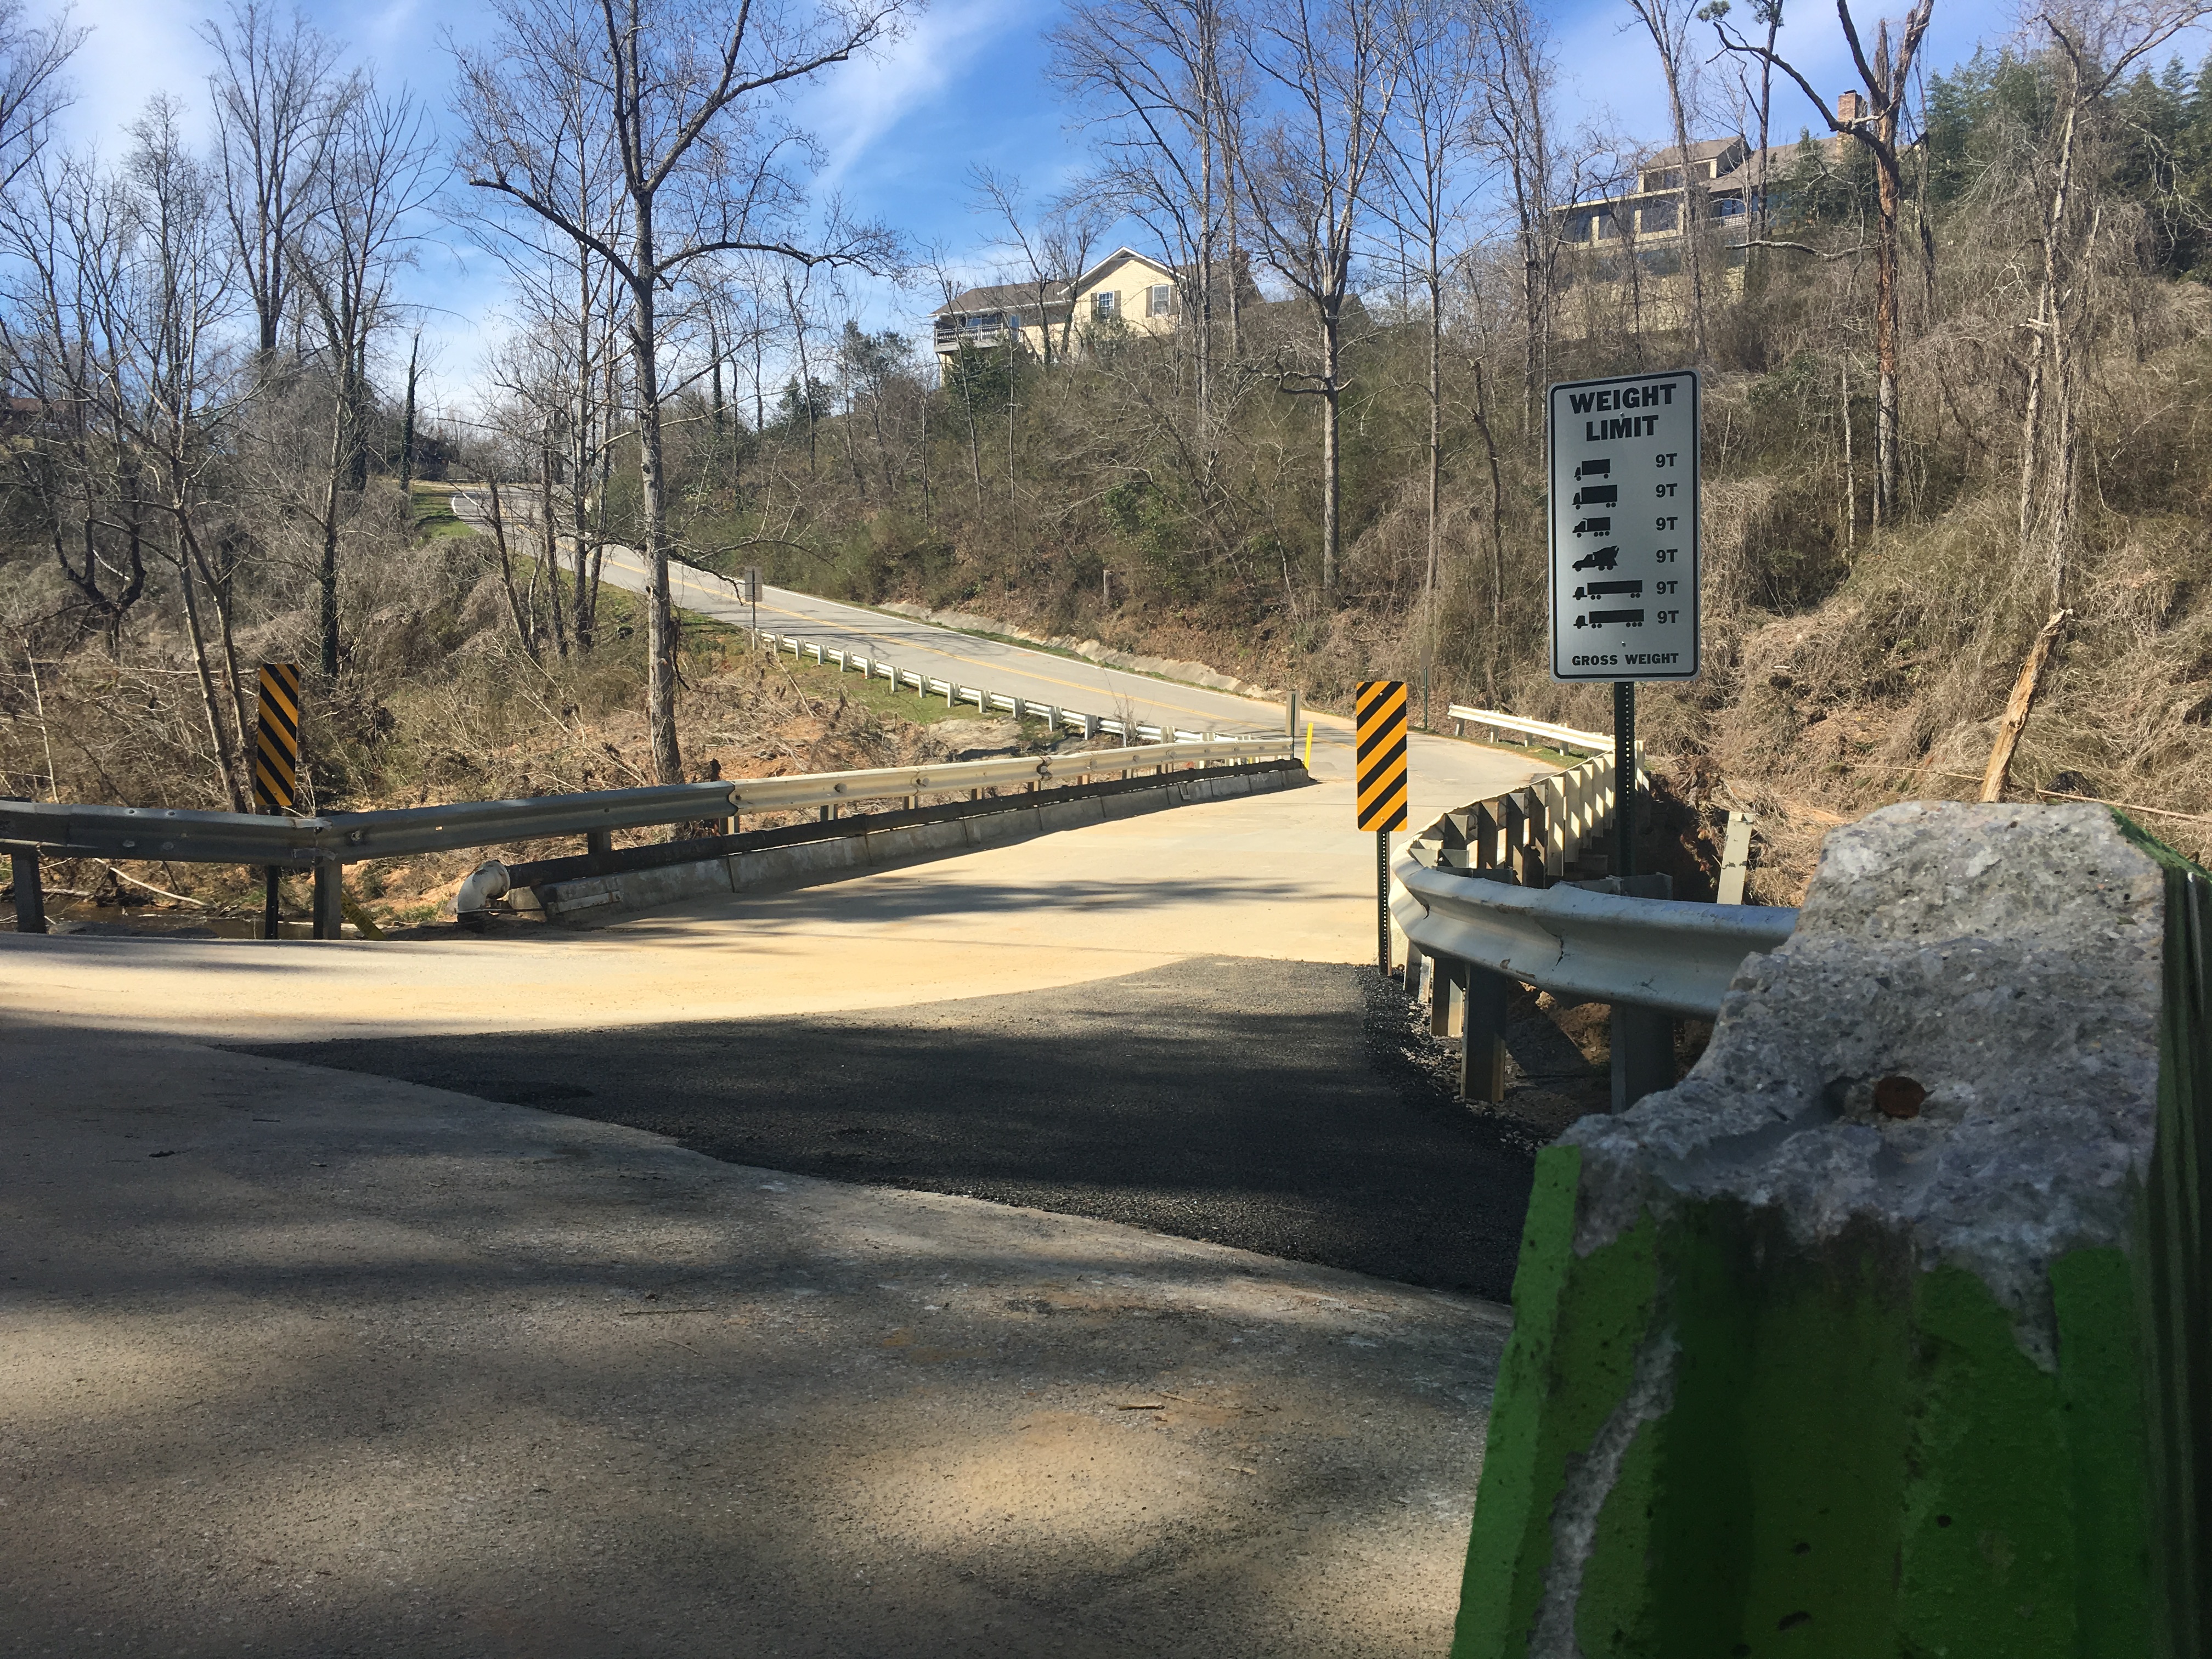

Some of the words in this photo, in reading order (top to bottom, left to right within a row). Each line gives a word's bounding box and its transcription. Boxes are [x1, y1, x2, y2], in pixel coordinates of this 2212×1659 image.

[1569, 383, 1677, 414] WEIGHT
[1586, 415, 1658, 442] LIMIT
[1655, 453, 1678, 468] 9T
[1655, 483, 1678, 498] 9T
[1656, 517, 1678, 531] 9T
[1656, 549, 1678, 563] 9T
[1656, 580, 1678, 595] 9T
[1657, 610, 1679, 624] 9T
[1572, 654, 1618, 666] GROSS
[1624, 653, 1679, 665] WEIGHT
